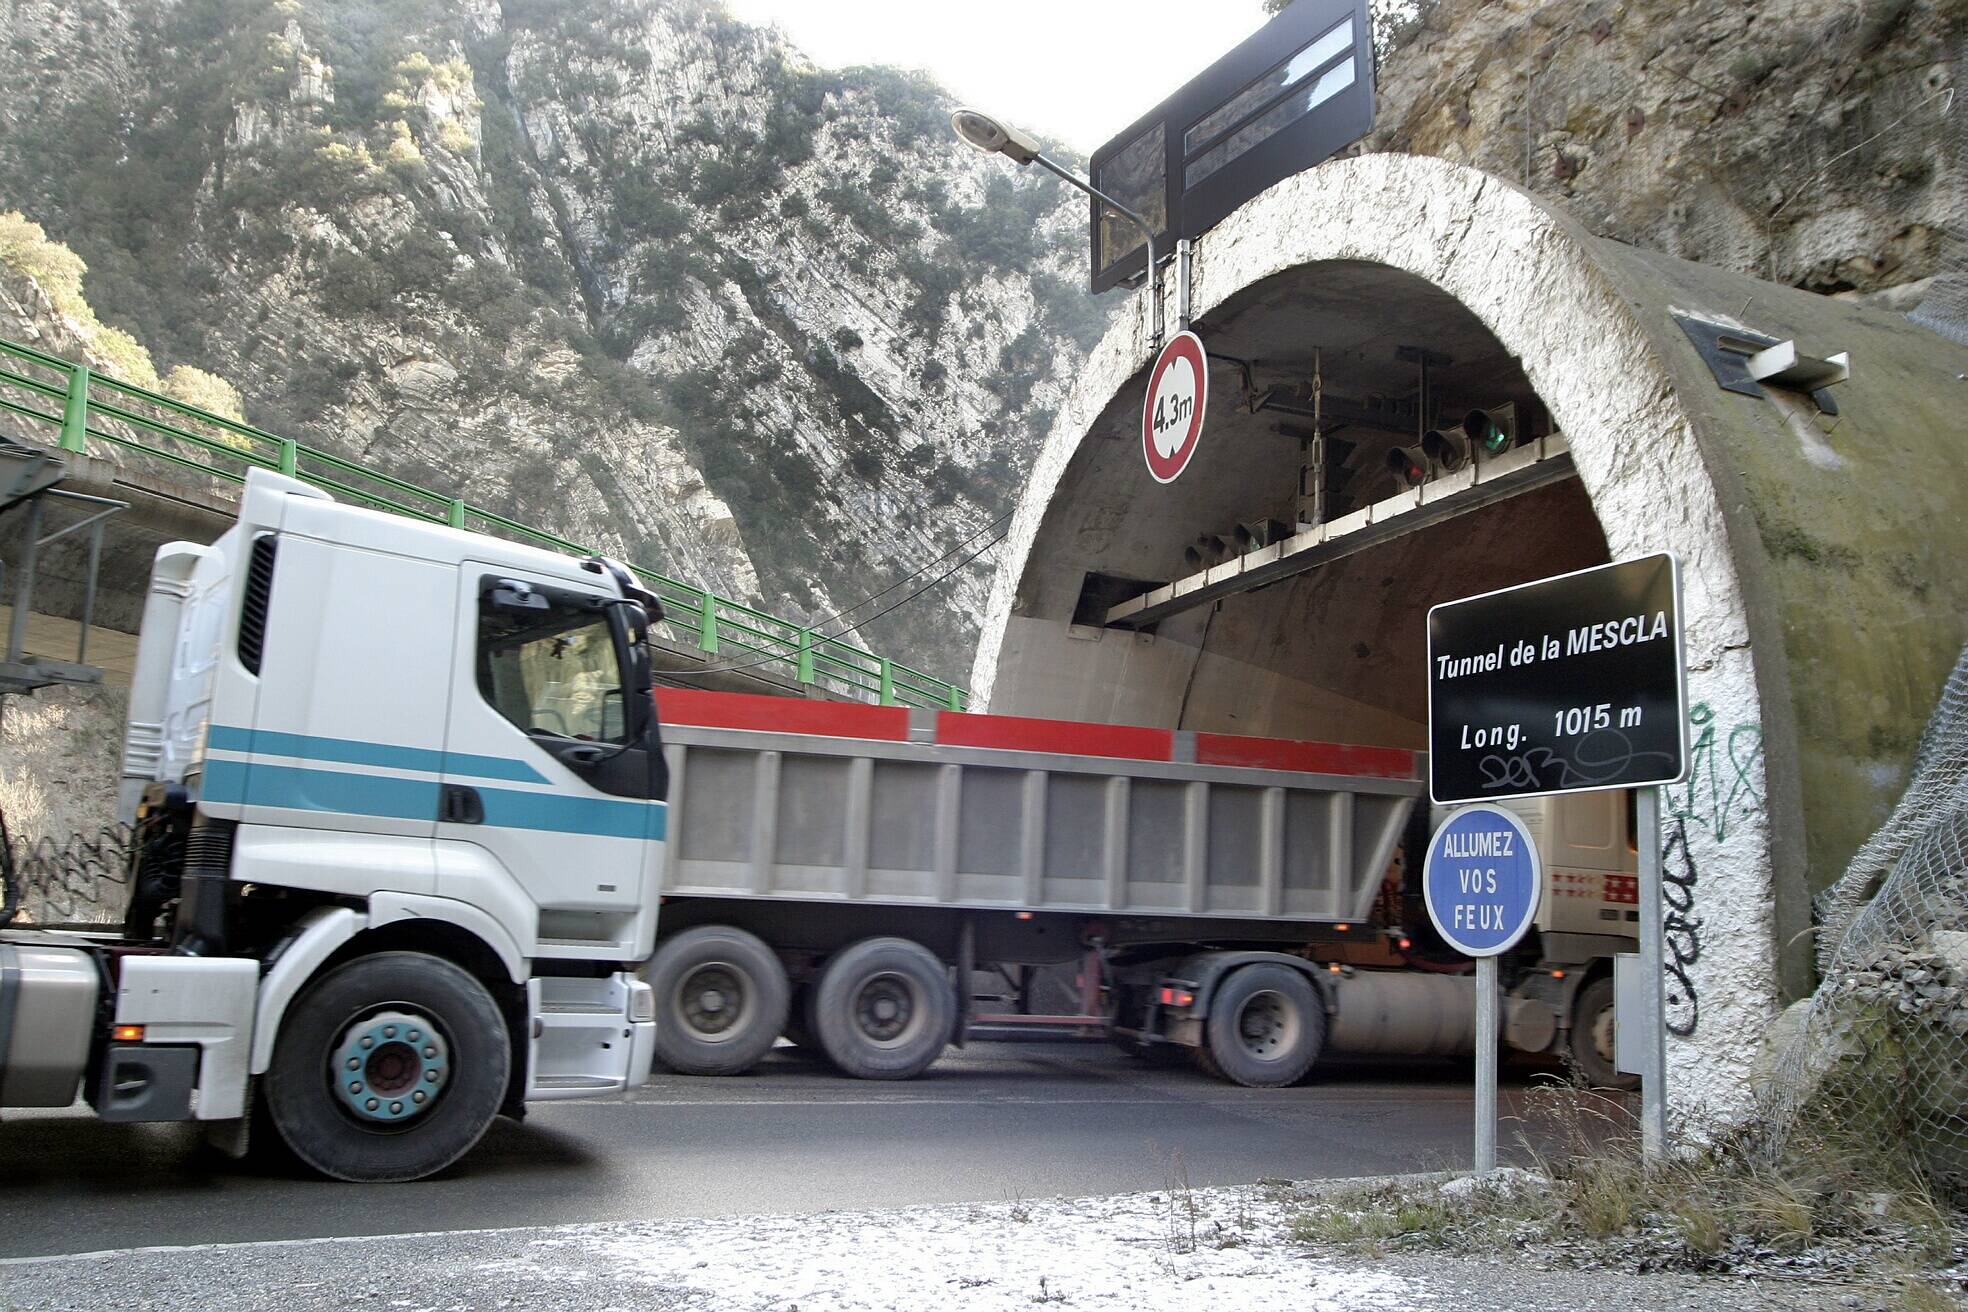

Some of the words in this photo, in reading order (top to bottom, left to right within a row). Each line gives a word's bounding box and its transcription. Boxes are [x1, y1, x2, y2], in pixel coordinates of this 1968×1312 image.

[1153, 393, 1192, 434] 4.3m
[1437, 644, 1503, 680] Tunnel
[1510, 639, 1535, 666] de
[1541, 634, 1560, 662] la
[1567, 611, 1668, 656] MESCLA
[1460, 724, 1528, 751] Long.
[1554, 703, 1612, 737] 1015
[1619, 706, 1642, 728] m
[1443, 831, 1514, 858] ALLUMEZ
[1459, 868, 1497, 894] VOS
[1454, 904, 1504, 930] FEUX
